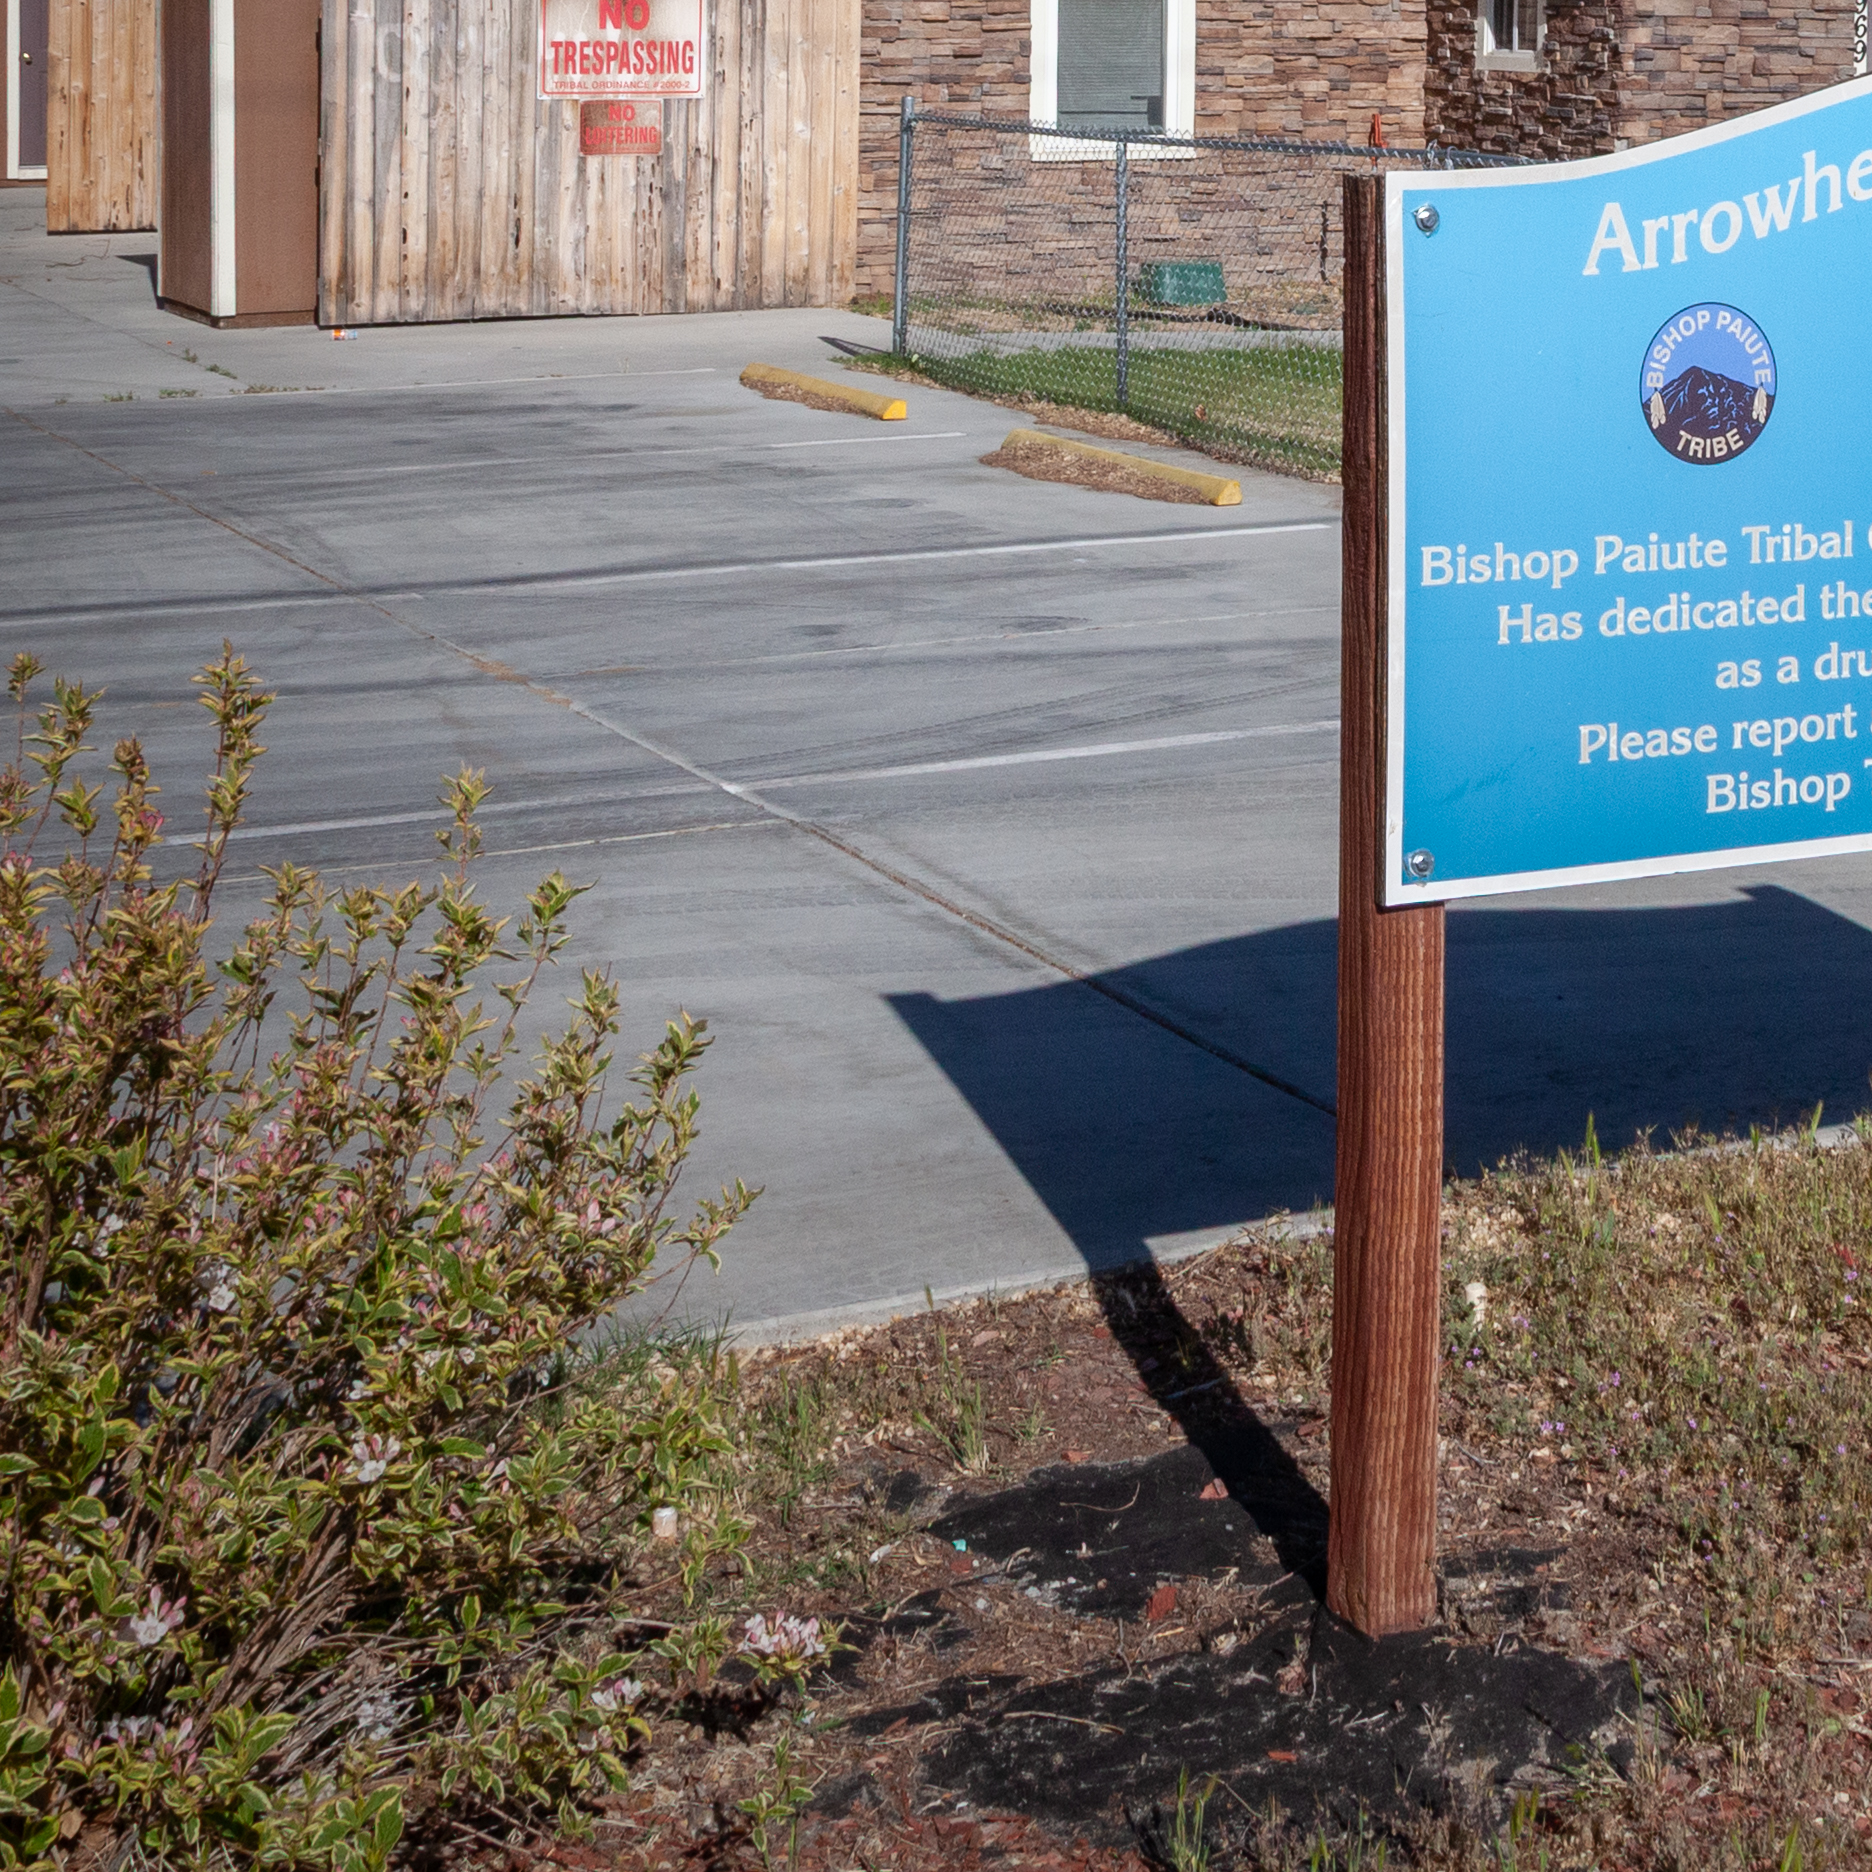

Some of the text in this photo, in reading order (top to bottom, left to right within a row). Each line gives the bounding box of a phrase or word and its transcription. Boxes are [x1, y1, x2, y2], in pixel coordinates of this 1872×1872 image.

[551, 40, 694, 76] TRESPASSING
[553, 81, 588, 90] TRIBAL
[591, 81, 649, 89] ORDINANCE
[608, 104, 636, 122] NO
[585, 125, 657, 145] LOITERING
[1646, 310, 1771, 388] BISHOP PAIUTE
[1677, 428, 1744, 458] TRIBE
[1421, 542, 1579, 589] Bishop
[1594, 532, 1727, 575] Paiute
[1741, 520, 1853, 564] Tribal
[1498, 603, 1583, 645] Has
[1599, 584, 1805, 637] dedicated
[1715, 659, 1762, 689] as
[1776, 656, 1799, 684] a
[1579, 722, 1718, 764] Please
[1732, 704, 1857, 756] report
[1706, 768, 1851, 813] Bishop
